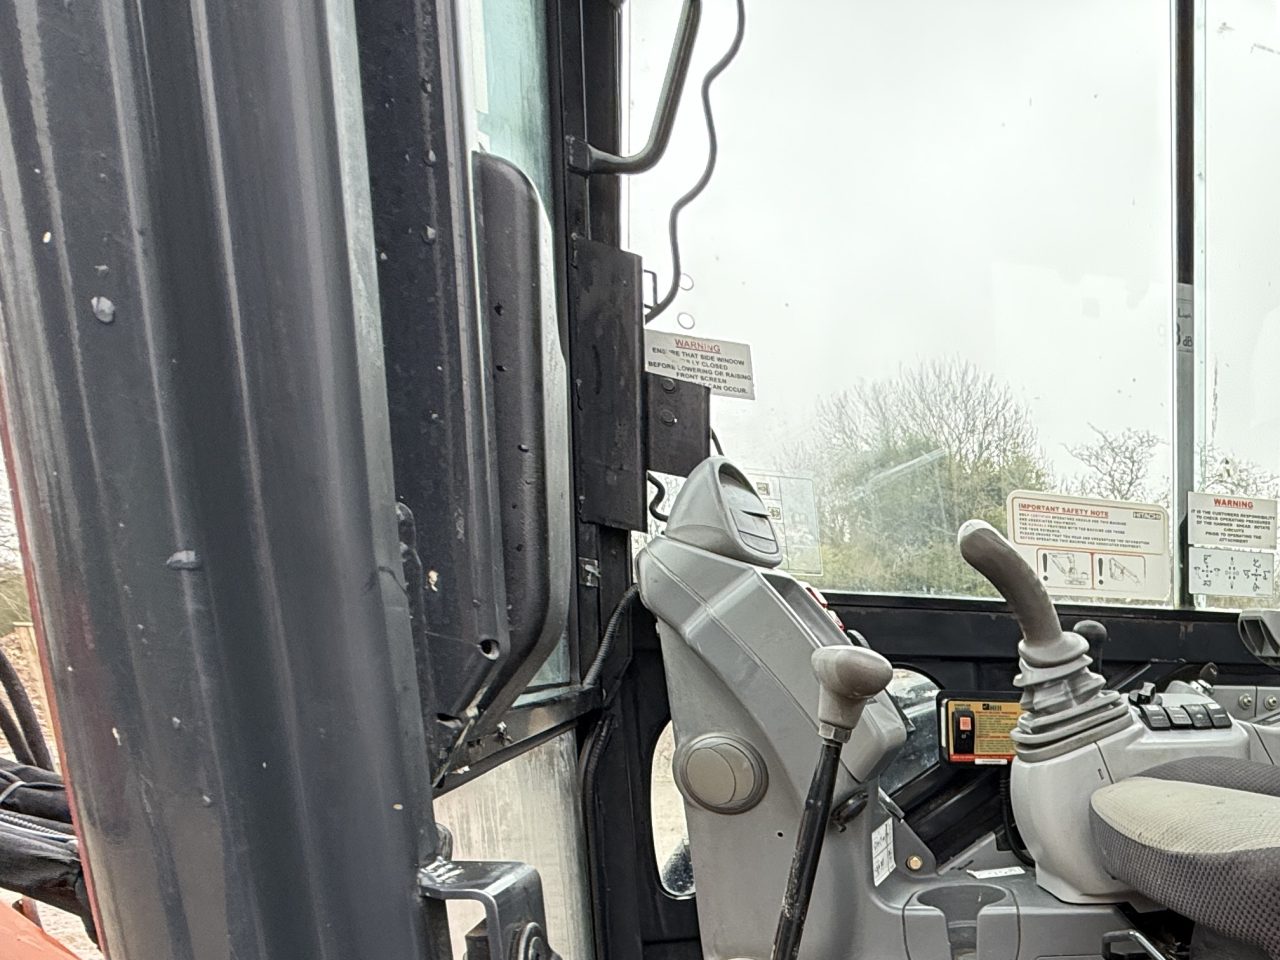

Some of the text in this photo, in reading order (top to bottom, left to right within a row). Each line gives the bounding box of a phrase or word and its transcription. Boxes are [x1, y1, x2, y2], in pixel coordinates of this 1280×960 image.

[675, 338, 721, 353] WARNING
[652, 347, 680, 357] ENSRE
[682, 351, 698, 359] THAT
[717, 357, 744, 366] WINDOW
[648, 361, 676, 370] BEFORE
[725, 372, 752, 381] RAISING
[701, 361, 728, 371] CLOSED
[676, 372, 698, 380] FRONT
[700, 375, 726, 384] SCREEN
[1018, 503, 1108, 519] IMPORTANT SAFETY NOTE
[1213, 498, 1254, 510] WARNING
